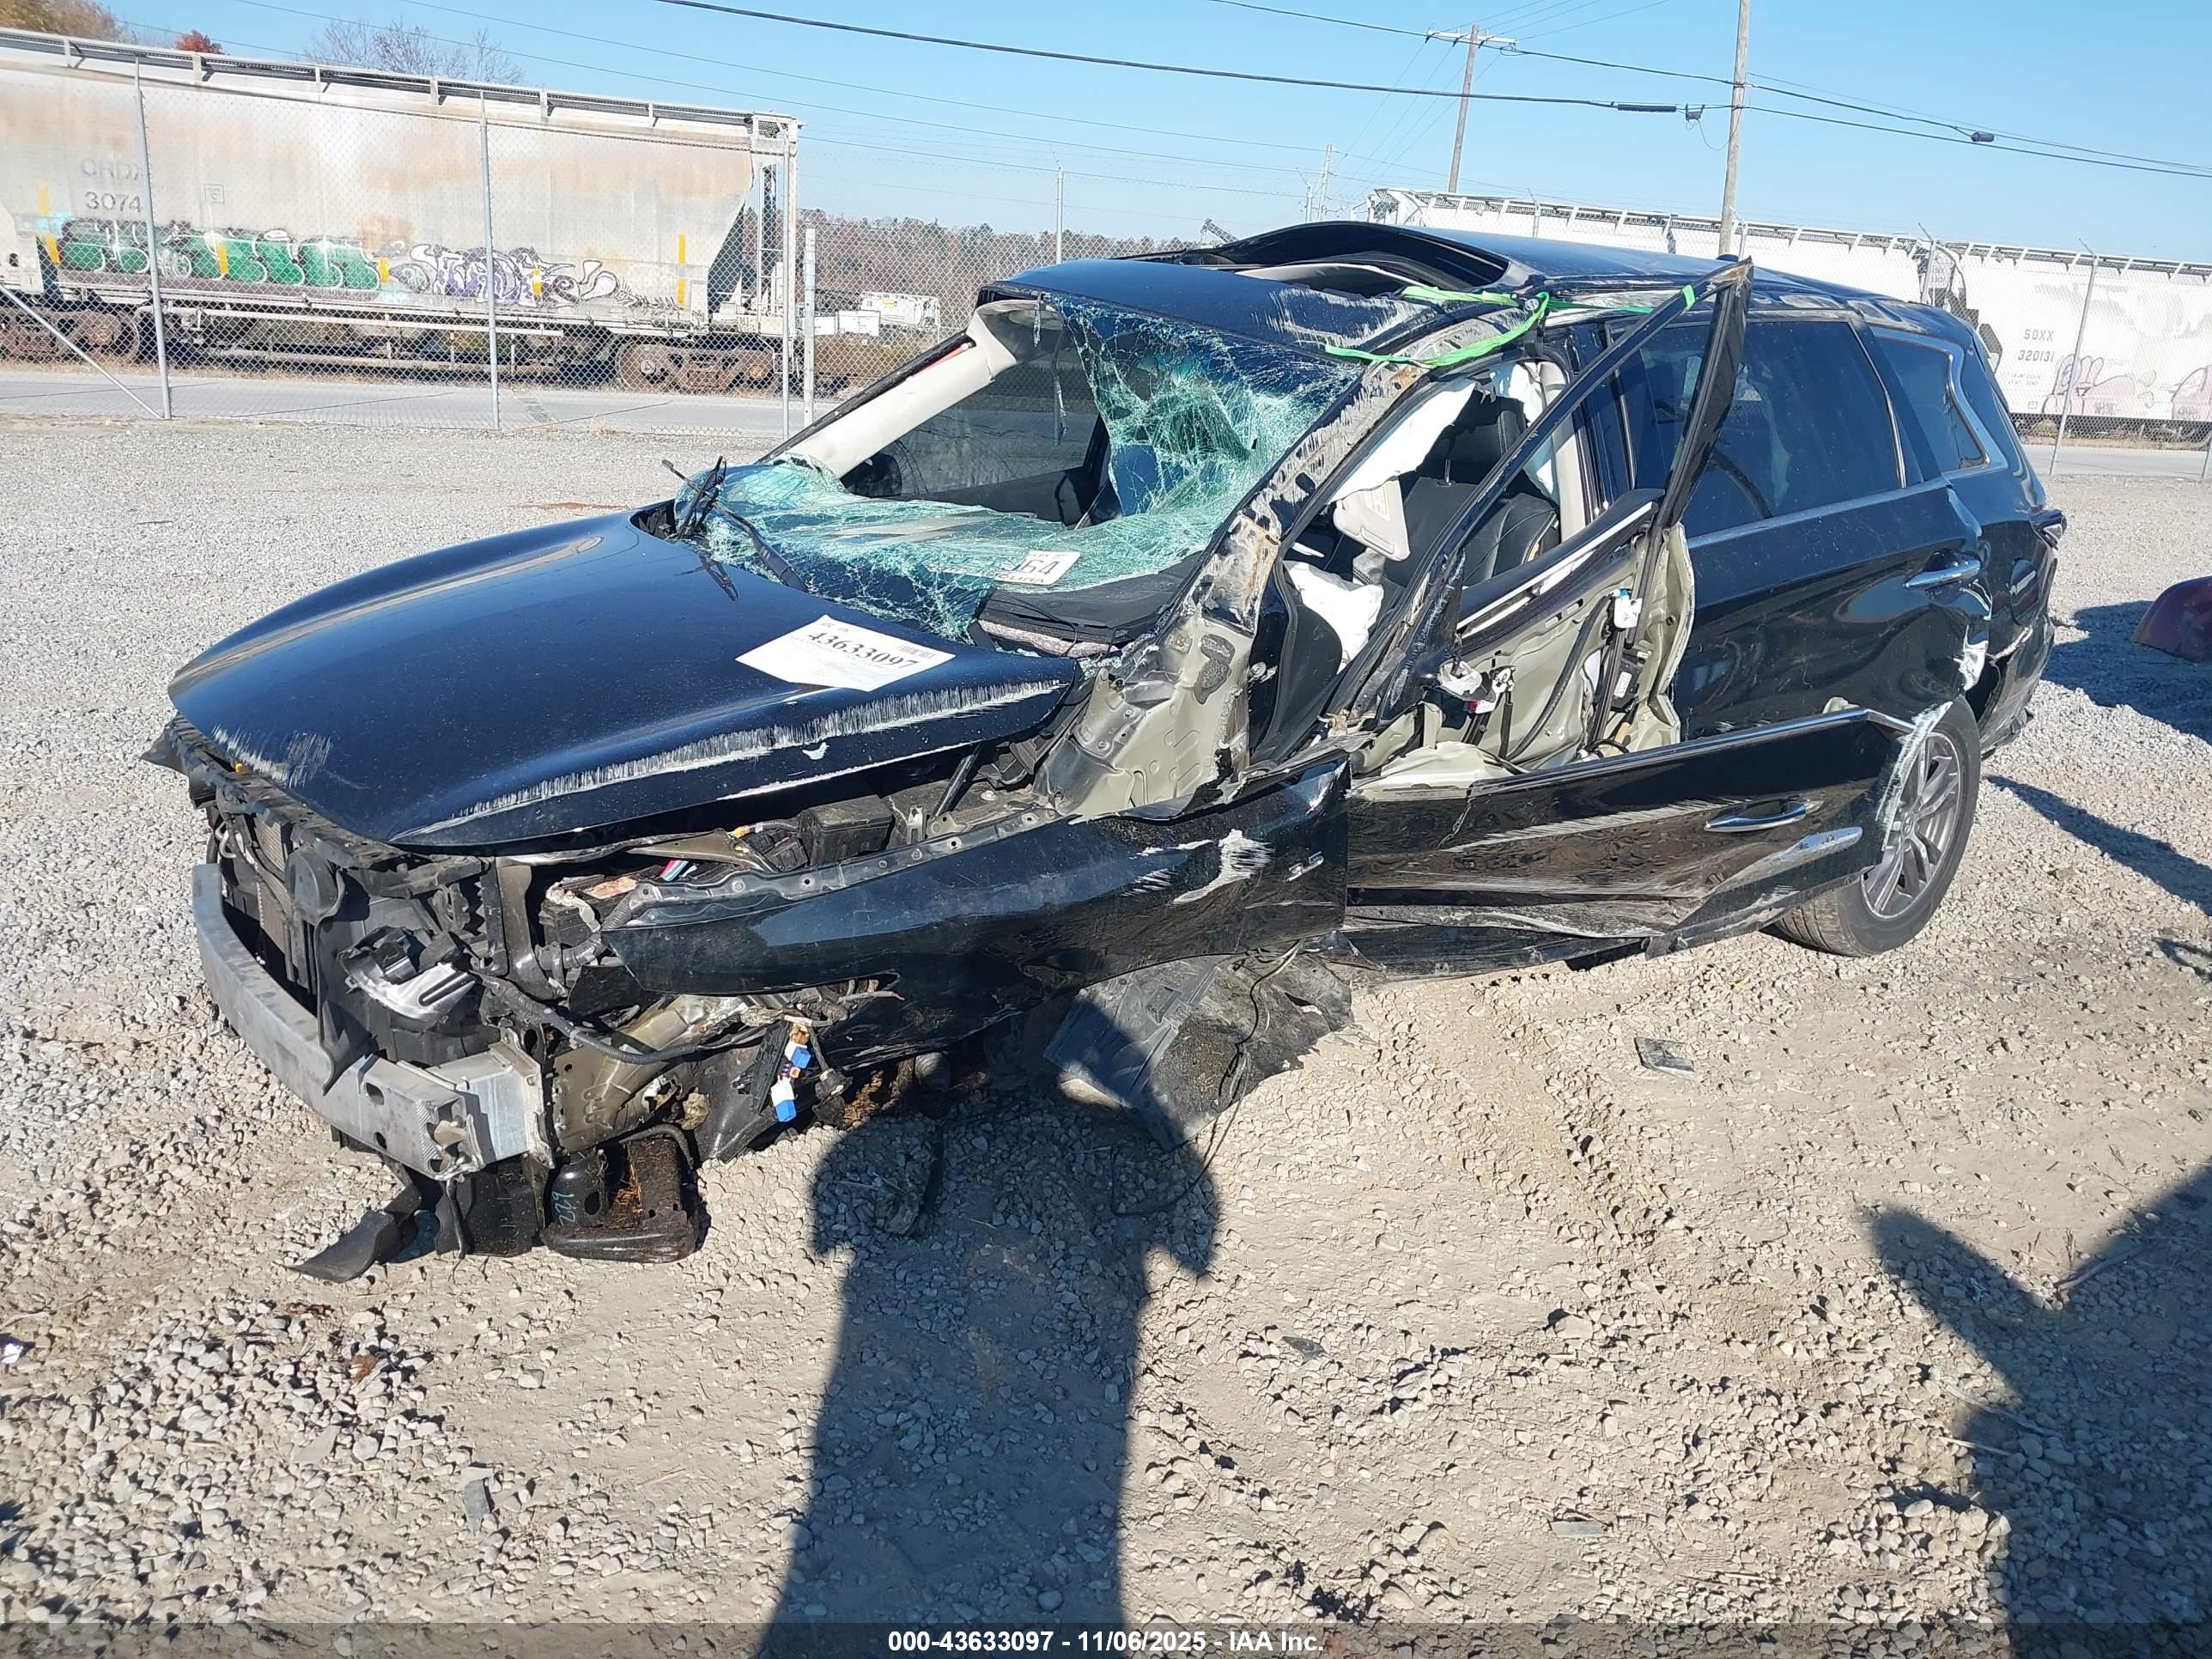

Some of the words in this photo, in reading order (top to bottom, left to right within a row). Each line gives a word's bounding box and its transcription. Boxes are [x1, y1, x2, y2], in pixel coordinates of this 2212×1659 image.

[83, 191, 142, 213] 3074
[2018, 349, 2054, 364] 320131
[808, 632, 920, 669] 43633097
